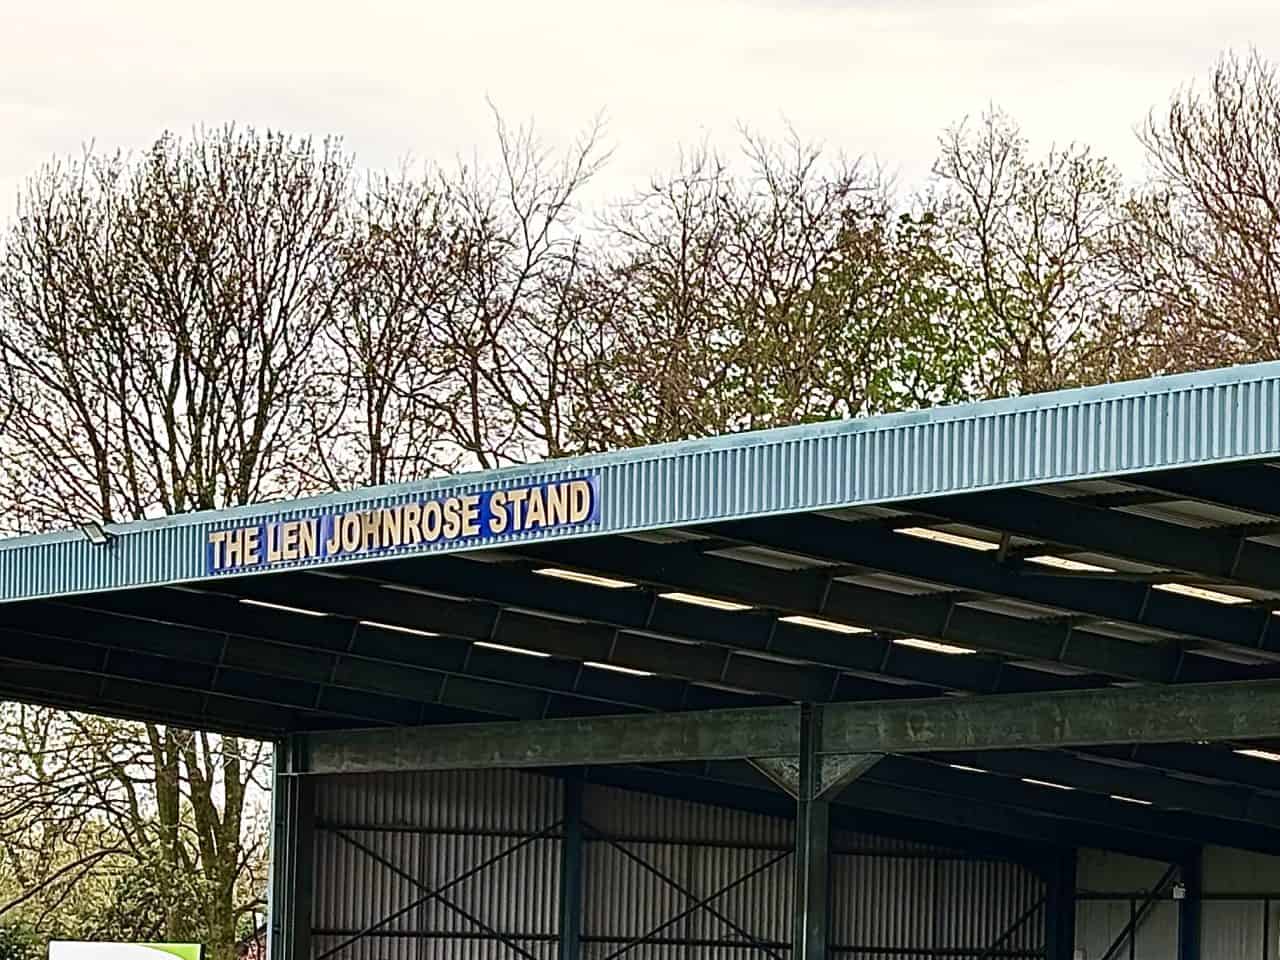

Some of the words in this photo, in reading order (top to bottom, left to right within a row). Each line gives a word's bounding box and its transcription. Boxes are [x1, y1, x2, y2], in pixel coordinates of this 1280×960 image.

[209, 530, 260, 568] THE
[267, 519, 316, 561] LEN
[328, 496, 480, 554] JOHNROSE
[489, 480, 595, 533] STAND
